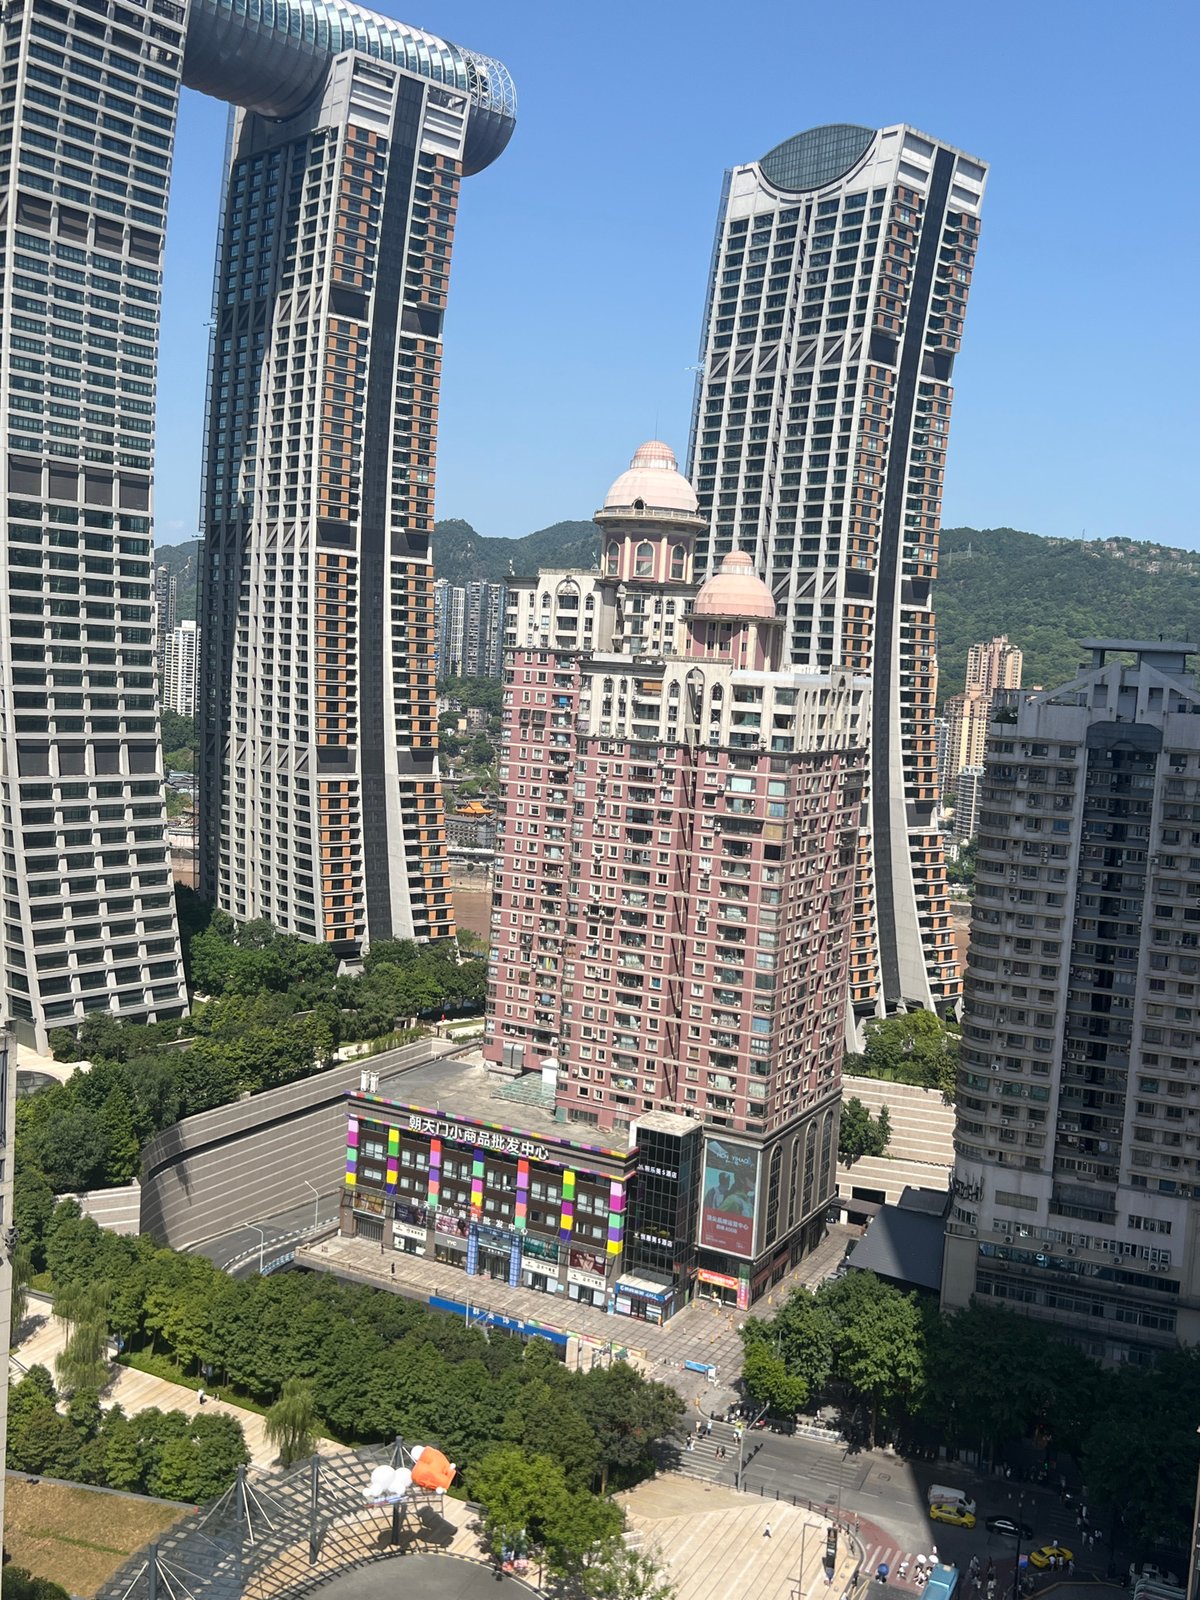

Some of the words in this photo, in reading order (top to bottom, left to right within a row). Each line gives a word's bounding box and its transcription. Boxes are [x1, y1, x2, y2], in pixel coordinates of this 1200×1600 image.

[408, 1114, 549, 1160] 朝天门小商品批发中心
